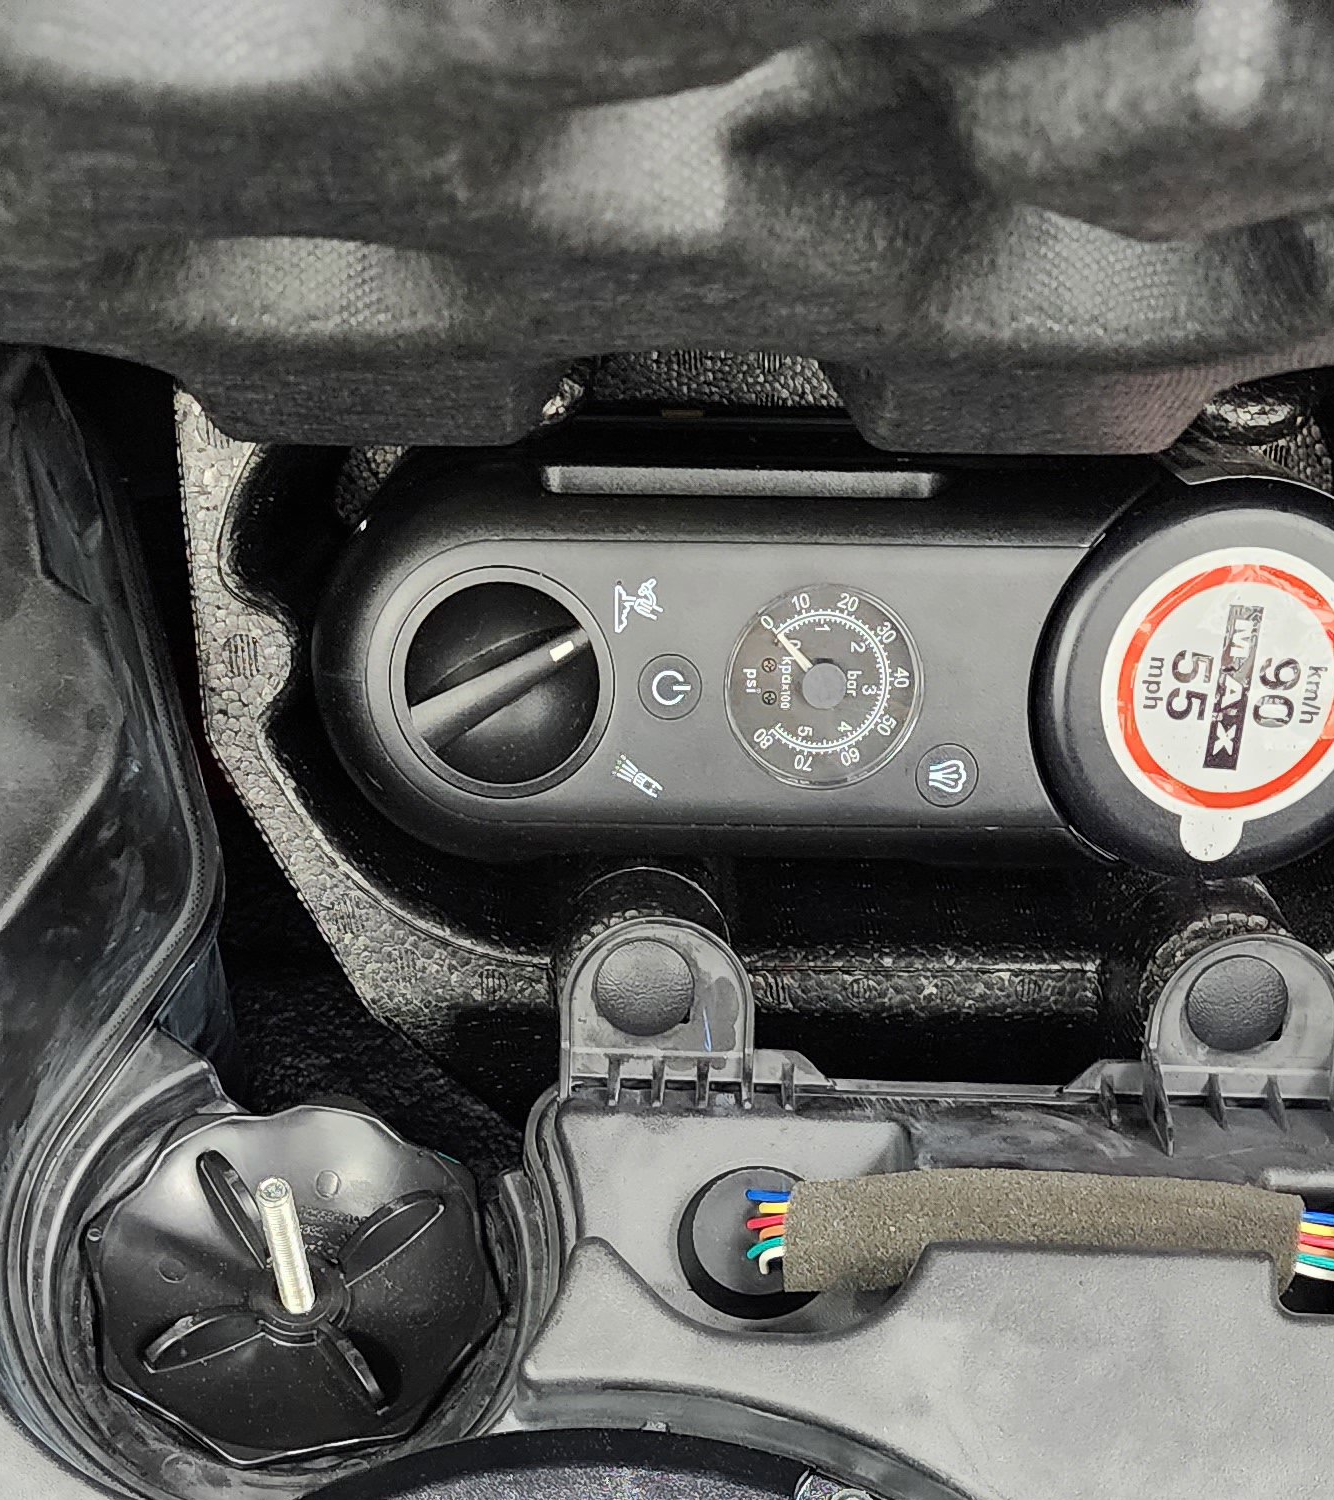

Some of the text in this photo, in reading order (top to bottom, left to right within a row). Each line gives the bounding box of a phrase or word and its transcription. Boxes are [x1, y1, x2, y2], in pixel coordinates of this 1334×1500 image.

[792, 593, 810, 611] 10
[837, 593, 859, 612] 20
[760, 615, 774, 630] 0
[815, 624, 831, 632] 1
[876, 621, 897, 643] 30
[851, 641, 866, 653] 2
[743, 668, 758, 694] psi
[847, 670, 862, 697] bar
[893, 666, 910, 688] 40
[1142, 656, 1165, 710] mph
[1166, 649, 1215, 722] 55
[1212, 618, 1257, 757] MAX
[862, 684, 877, 696] 3
[1252, 657, 1302, 729] 90
[1299, 665, 1328, 725] km/h
[797, 725, 813, 737] 5
[838, 721, 853, 732] 4
[876, 714, 897, 736] 50
[753, 728, 774, 749] 80
[794, 754, 813, 772] 70
[841, 747, 860, 766] 60
